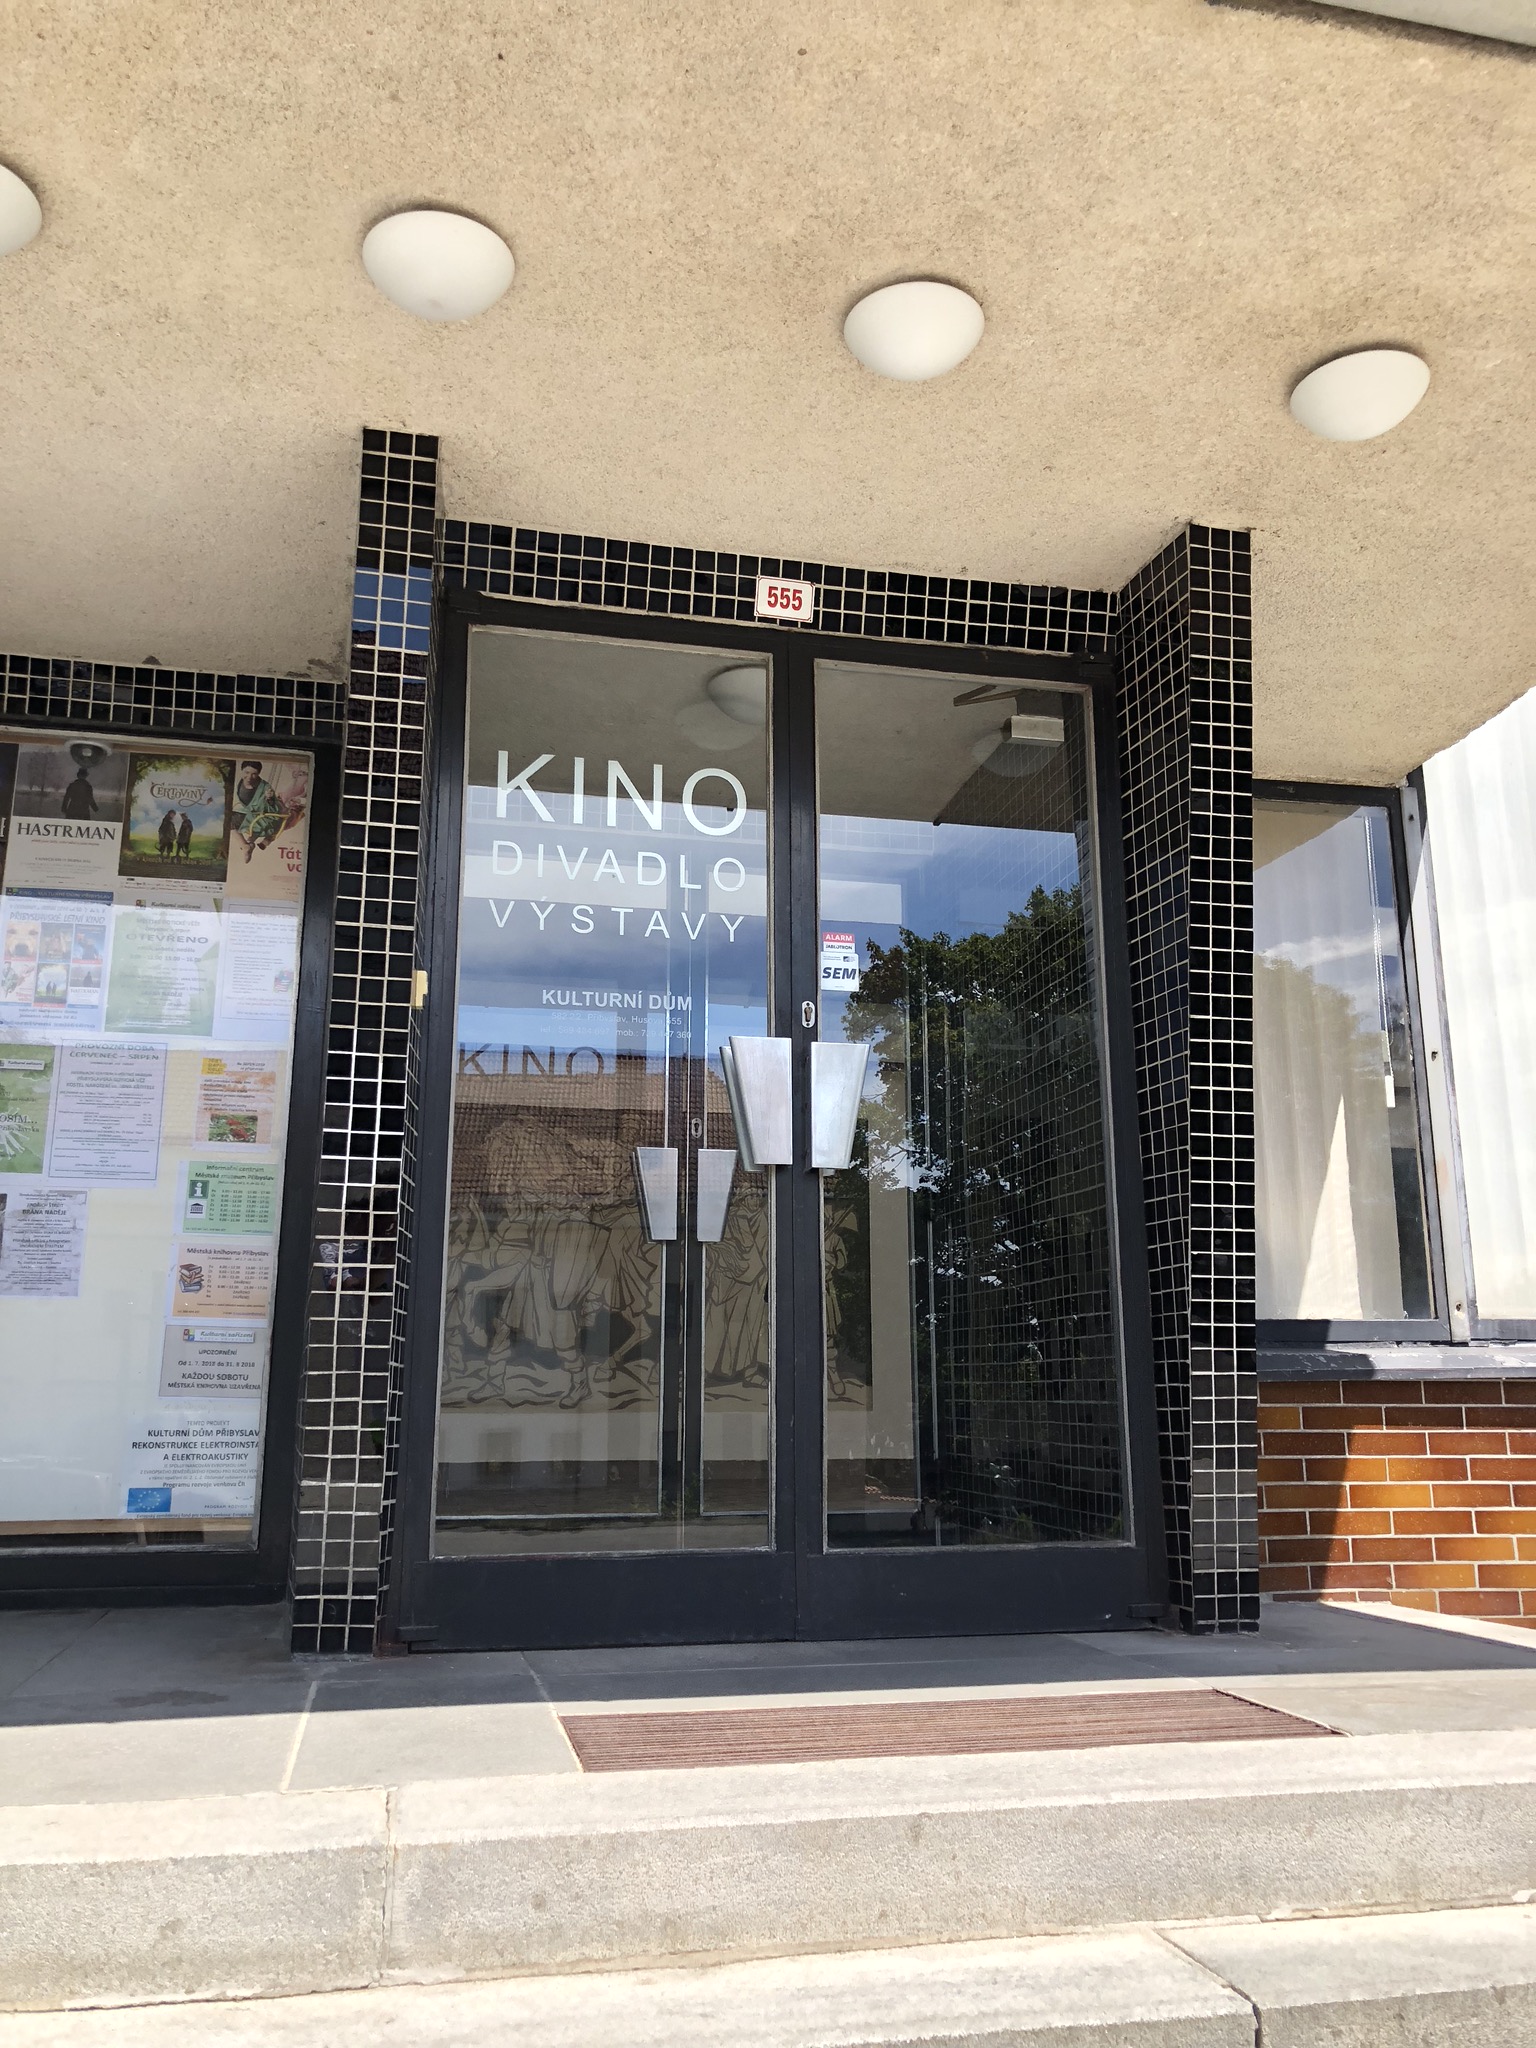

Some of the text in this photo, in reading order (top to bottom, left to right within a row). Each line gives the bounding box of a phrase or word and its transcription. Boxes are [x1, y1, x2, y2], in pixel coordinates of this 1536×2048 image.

[767, 585, 803, 611] 555
[496, 750, 747, 836] KINO
[17, 822, 116, 841] HASTRMAN
[492, 840, 746, 892] DIVADLO
[488, 896, 745, 943] VÝSTAVY
[126, 933, 209, 944] OTEVŘENO
[825, 934, 853, 942] ALARM
[822, 967, 857, 980] SEM
[542, 989, 693, 1011] KULTURNÍ DŮM
[127, 1044, 155, 1052] DOBA
[69, 1050, 118, 1059] ČERVENEC
[186, 1247, 213, 1255] Městská
[181, 1372, 249, 1381] KAŽDOU SOBOTU
[167, 1381, 195, 1389] MĚSTSKÁ
[229, 1382, 261, 1390] UZAVŘENA
[147, 1428, 260, 1437] KULTURNÍ DŮM PŘIBYSLAV
[131, 1441, 198, 1450] REKONSTRUKCE
[163, 1453, 249, 1462] A ELEKTROAKUSTIKY
